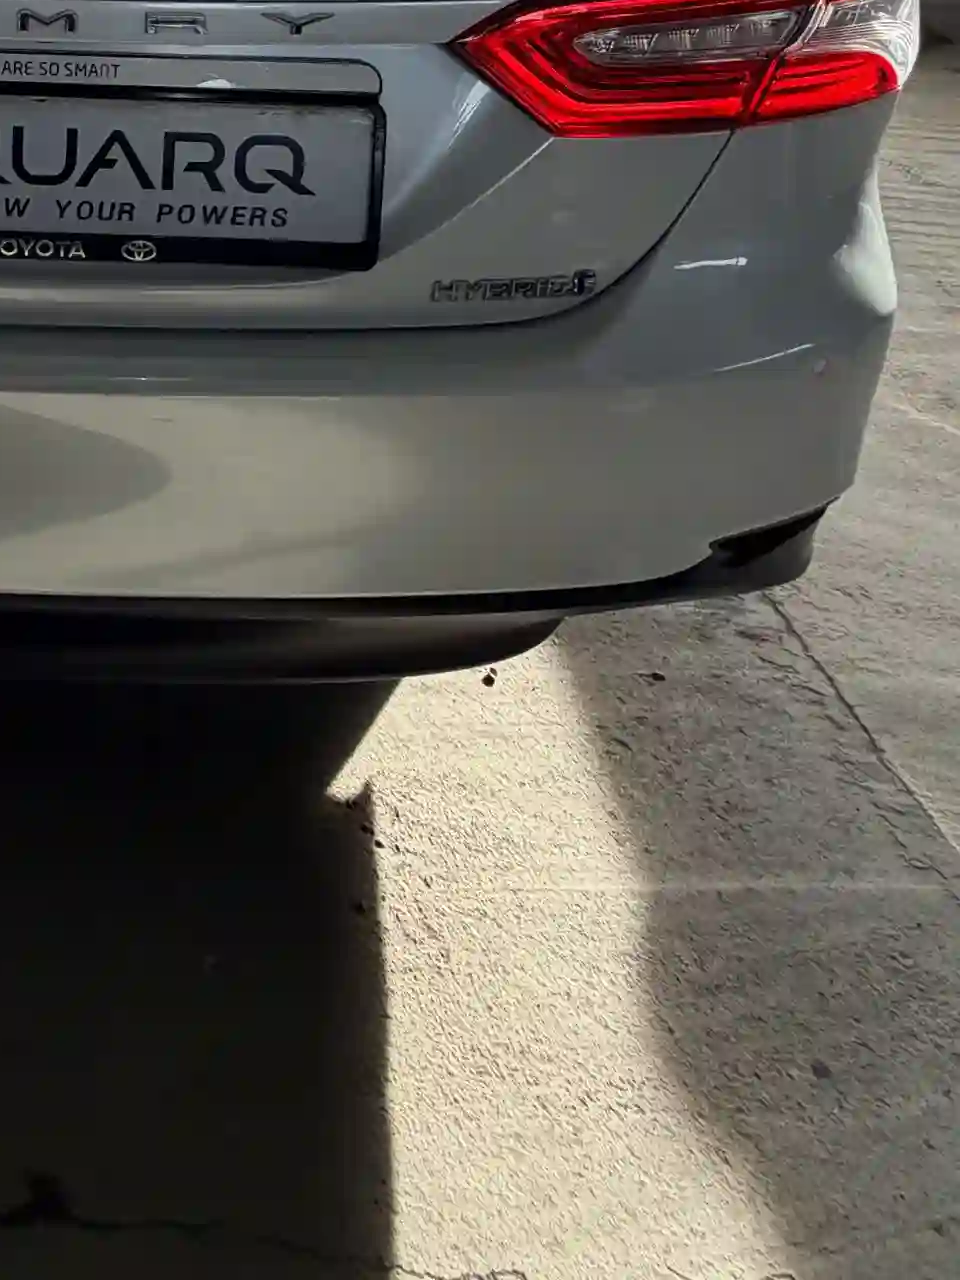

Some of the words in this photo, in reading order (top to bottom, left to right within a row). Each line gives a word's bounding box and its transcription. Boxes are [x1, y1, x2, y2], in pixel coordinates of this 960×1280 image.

[1, 60, 33, 76] ARE
[39, 61, 60, 77] SO
[63, 62, 121, 79] SMART
[54, 198, 138, 224] YOUR
[157, 203, 289, 228] POWERS
[431, 275, 575, 302] HYBRID
